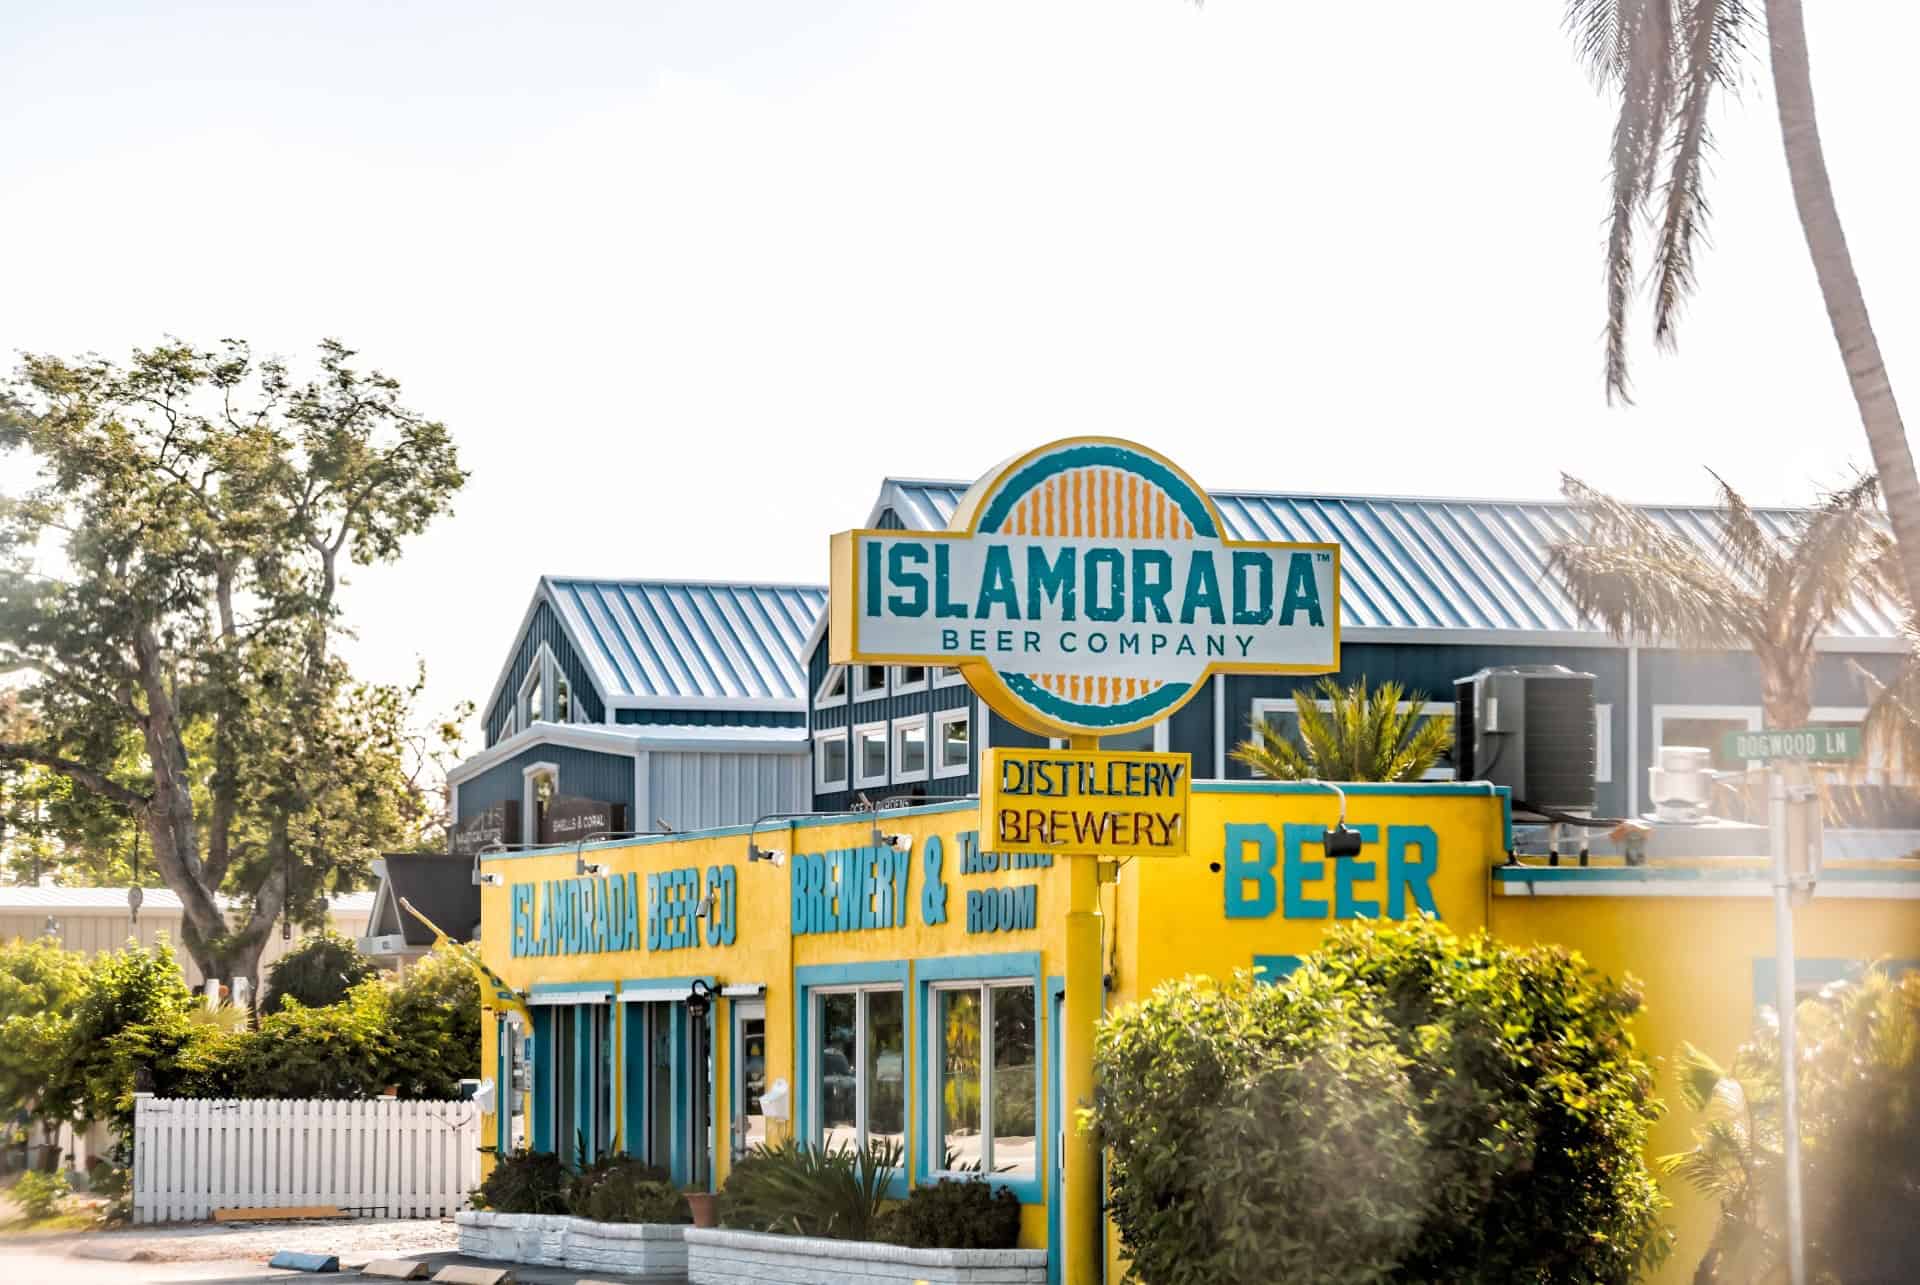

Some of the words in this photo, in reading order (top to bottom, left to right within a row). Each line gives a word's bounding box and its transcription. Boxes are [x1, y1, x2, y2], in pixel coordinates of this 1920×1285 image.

[867, 541, 1325, 627] ISLAMORADA
[942, 629, 1041, 652] BEER
[1059, 631, 1254, 657] COMPANY
[1737, 733, 1816, 757] DOGWOOD
[1826, 731, 1846, 754] LN
[1002, 759, 1184, 797] DISTILLERY
[1000, 808, 1181, 847] BREWERY
[791, 842, 911, 936] BREWERY
[921, 834, 948, 927] &
[1224, 822, 1441, 921] BEER
[511, 870, 641, 958] ISLAMORADA
[647, 867, 701, 953] BEER
[704, 864, 737, 947] CO
[966, 883, 1038, 934] ROOM
